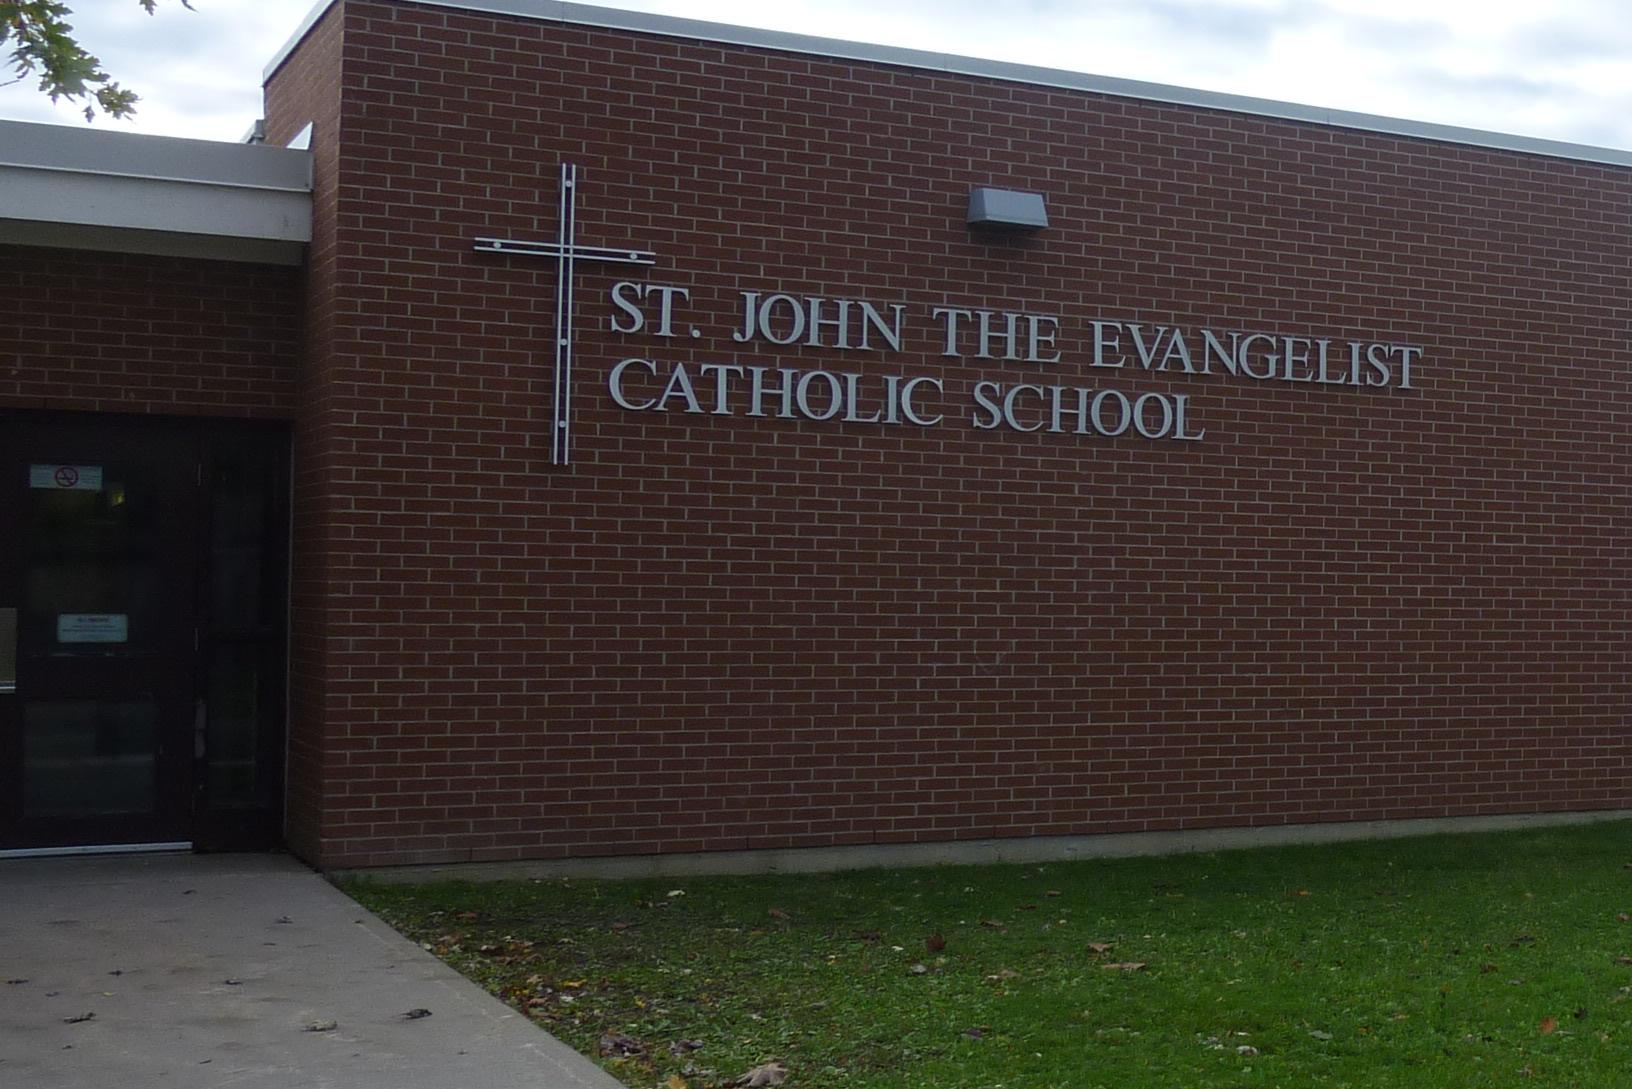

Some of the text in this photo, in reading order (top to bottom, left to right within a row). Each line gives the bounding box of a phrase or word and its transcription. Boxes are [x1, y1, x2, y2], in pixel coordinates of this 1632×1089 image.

[611, 282, 1423, 389] ST. JOHN THE EVANGELIST
[608, 358, 1206, 441] CATHOLIC SCHOOL
